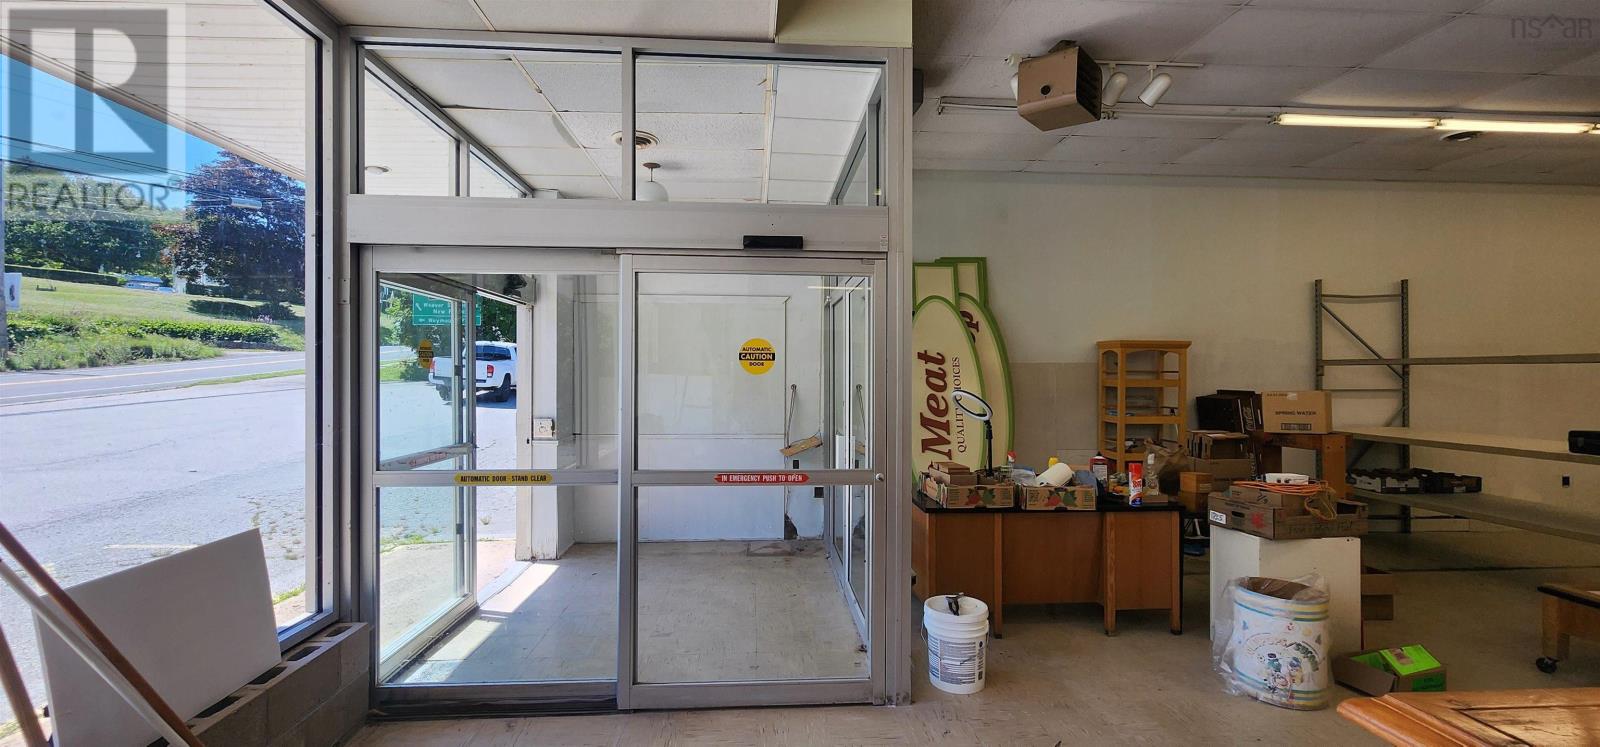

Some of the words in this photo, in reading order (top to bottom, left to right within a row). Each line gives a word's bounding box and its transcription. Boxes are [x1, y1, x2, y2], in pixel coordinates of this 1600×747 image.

[917, 350, 953, 460] Meat
[955, 407, 967, 453] QUALIT
[721, 474, 728, 482] IN
[729, 474, 761, 482] EMERGENCY
[762, 474, 777, 482] PUSH
[778, 474, 786, 482] TO
[787, 474, 803, 482] OPEN
